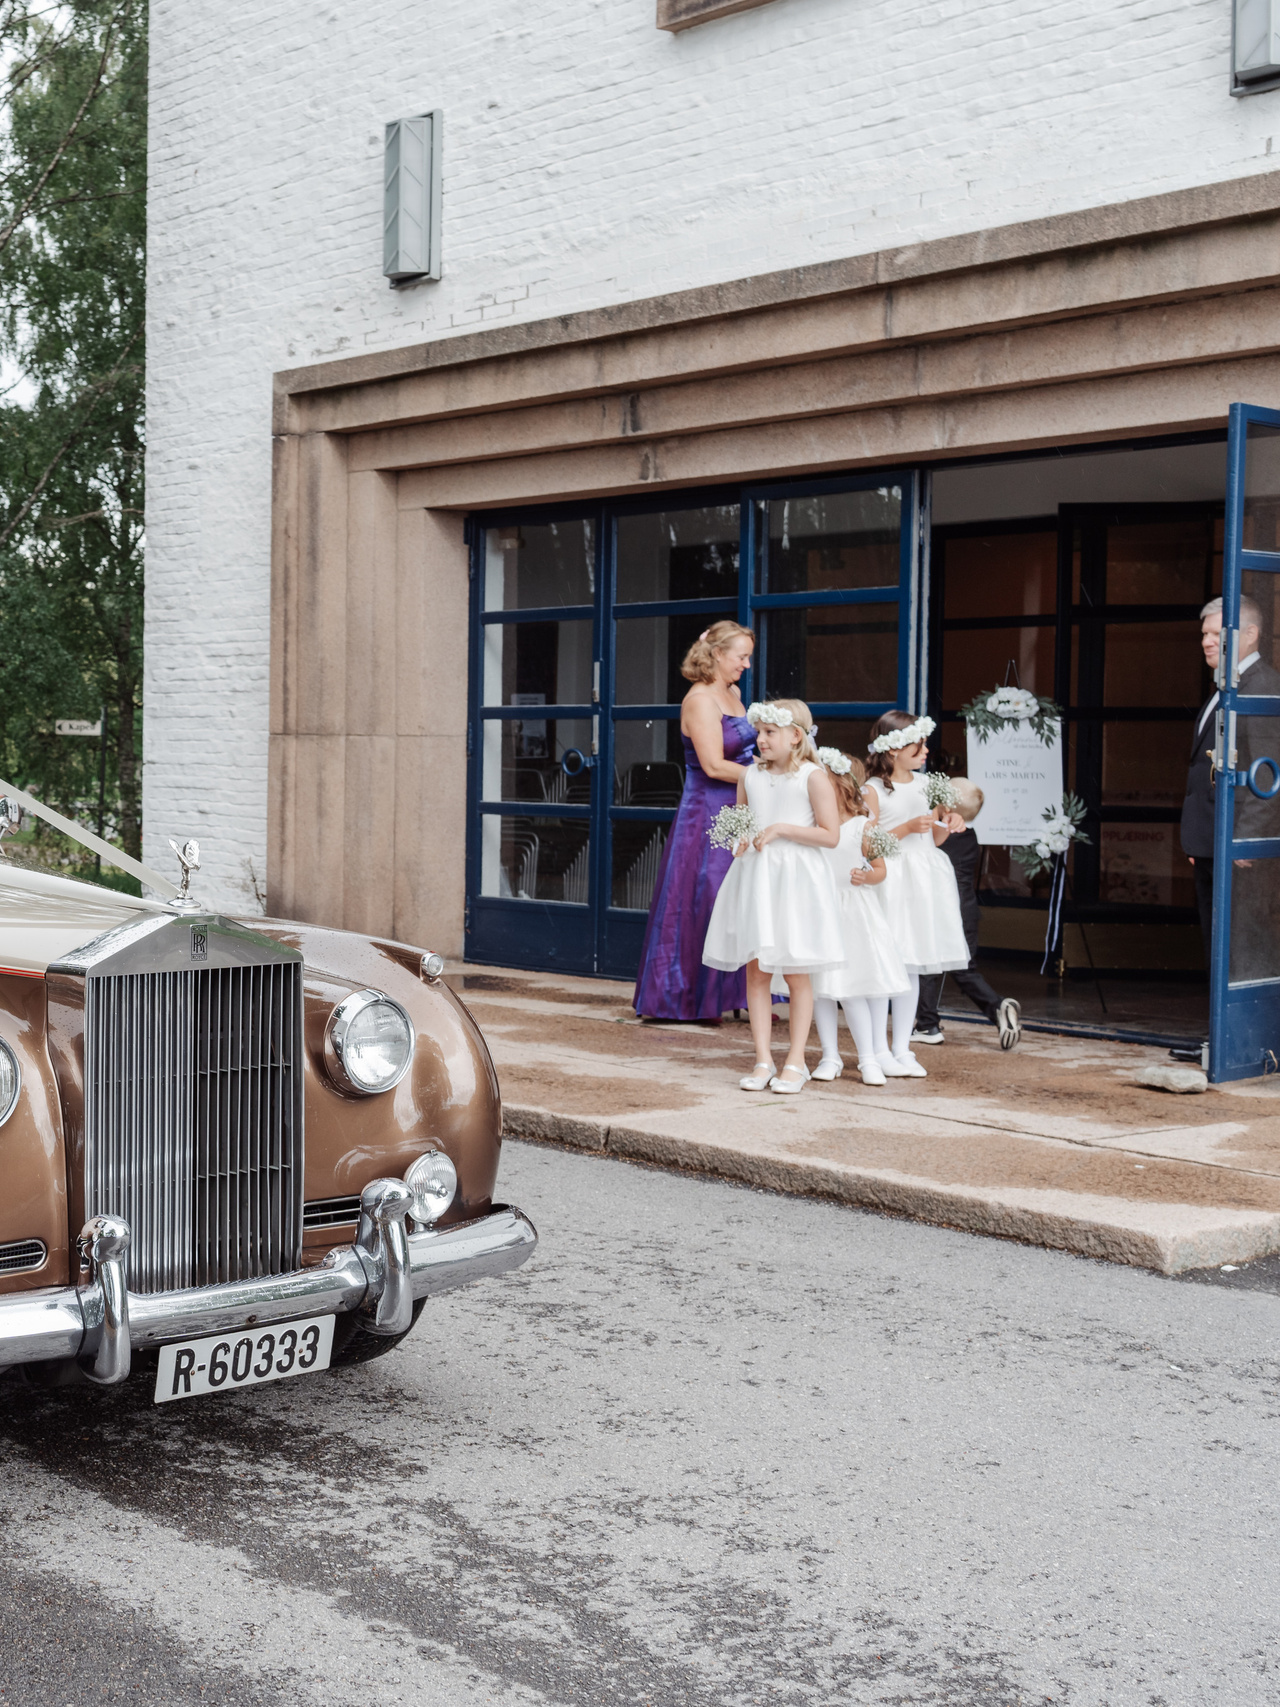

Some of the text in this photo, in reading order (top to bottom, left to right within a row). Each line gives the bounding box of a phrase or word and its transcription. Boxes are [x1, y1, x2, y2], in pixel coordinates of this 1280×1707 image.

[996, 759, 1021, 767] STINE
[985, 771, 1045, 780] LARS MARTIN
[172, 1324, 320, 1396] R-60333
